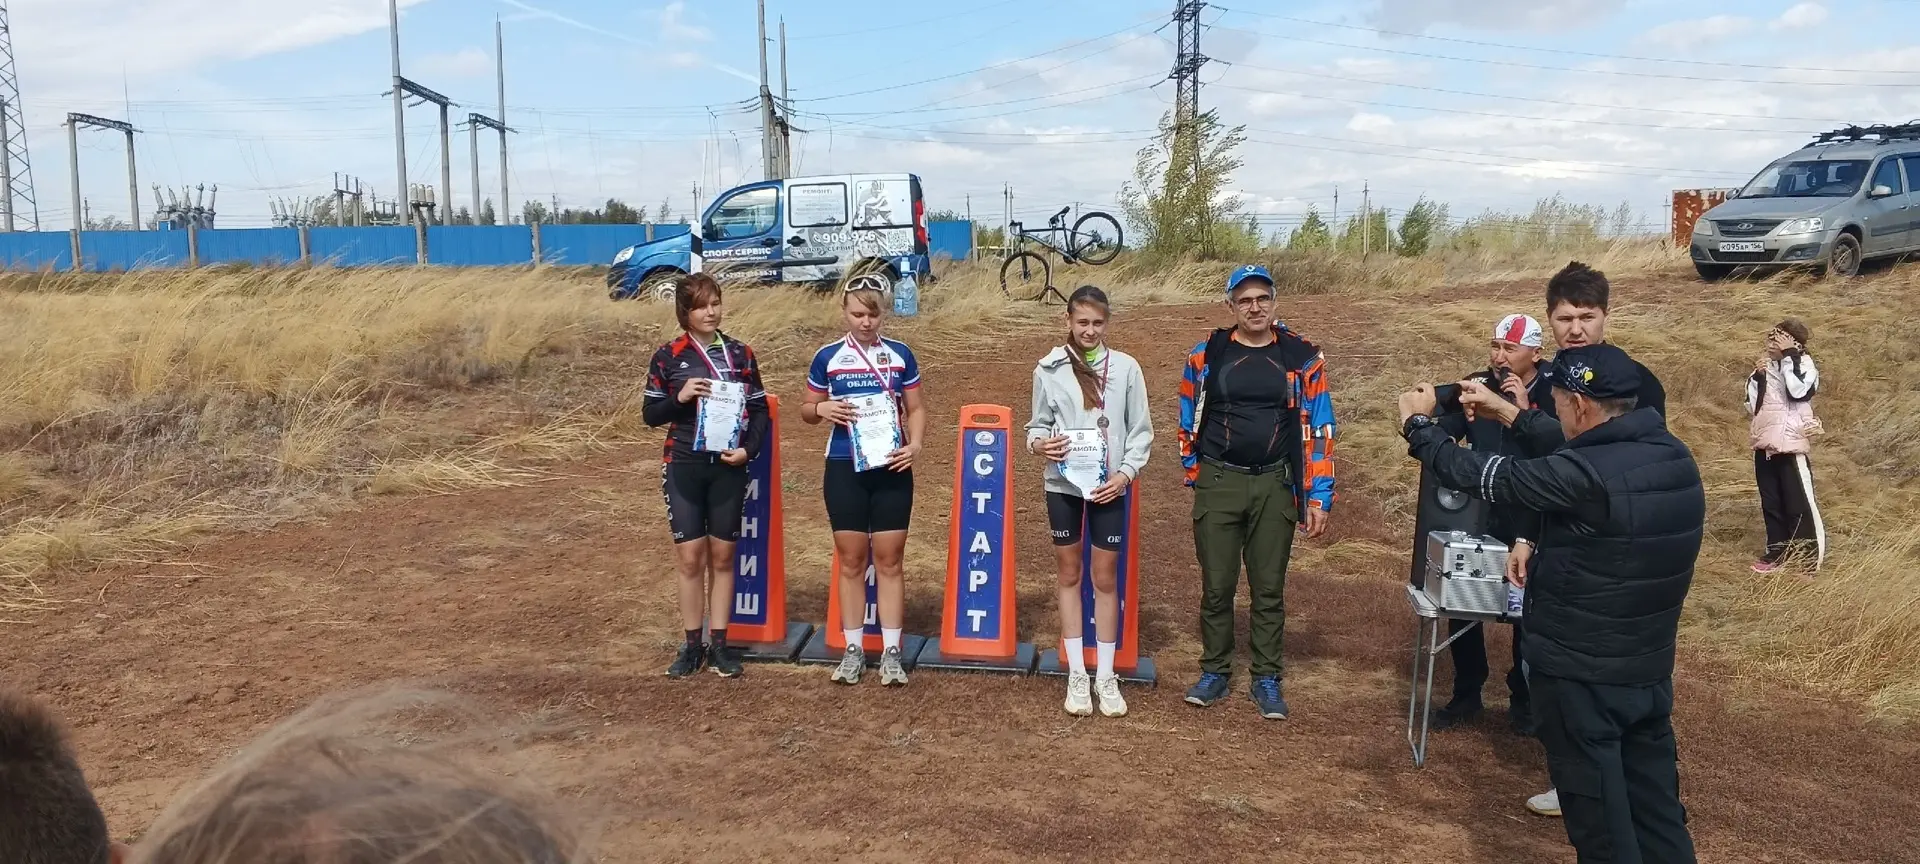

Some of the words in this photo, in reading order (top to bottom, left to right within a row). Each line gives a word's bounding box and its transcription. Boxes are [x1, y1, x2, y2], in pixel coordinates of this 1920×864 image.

[702, 249, 734, 258] СПОРТ
[735, 247, 772, 256] СЕРВИС
[846, 379, 884, 388] ОБЛАС
[736, 452, 760, 615] ИНИШ
[967, 453, 995, 632] СТАРТ
